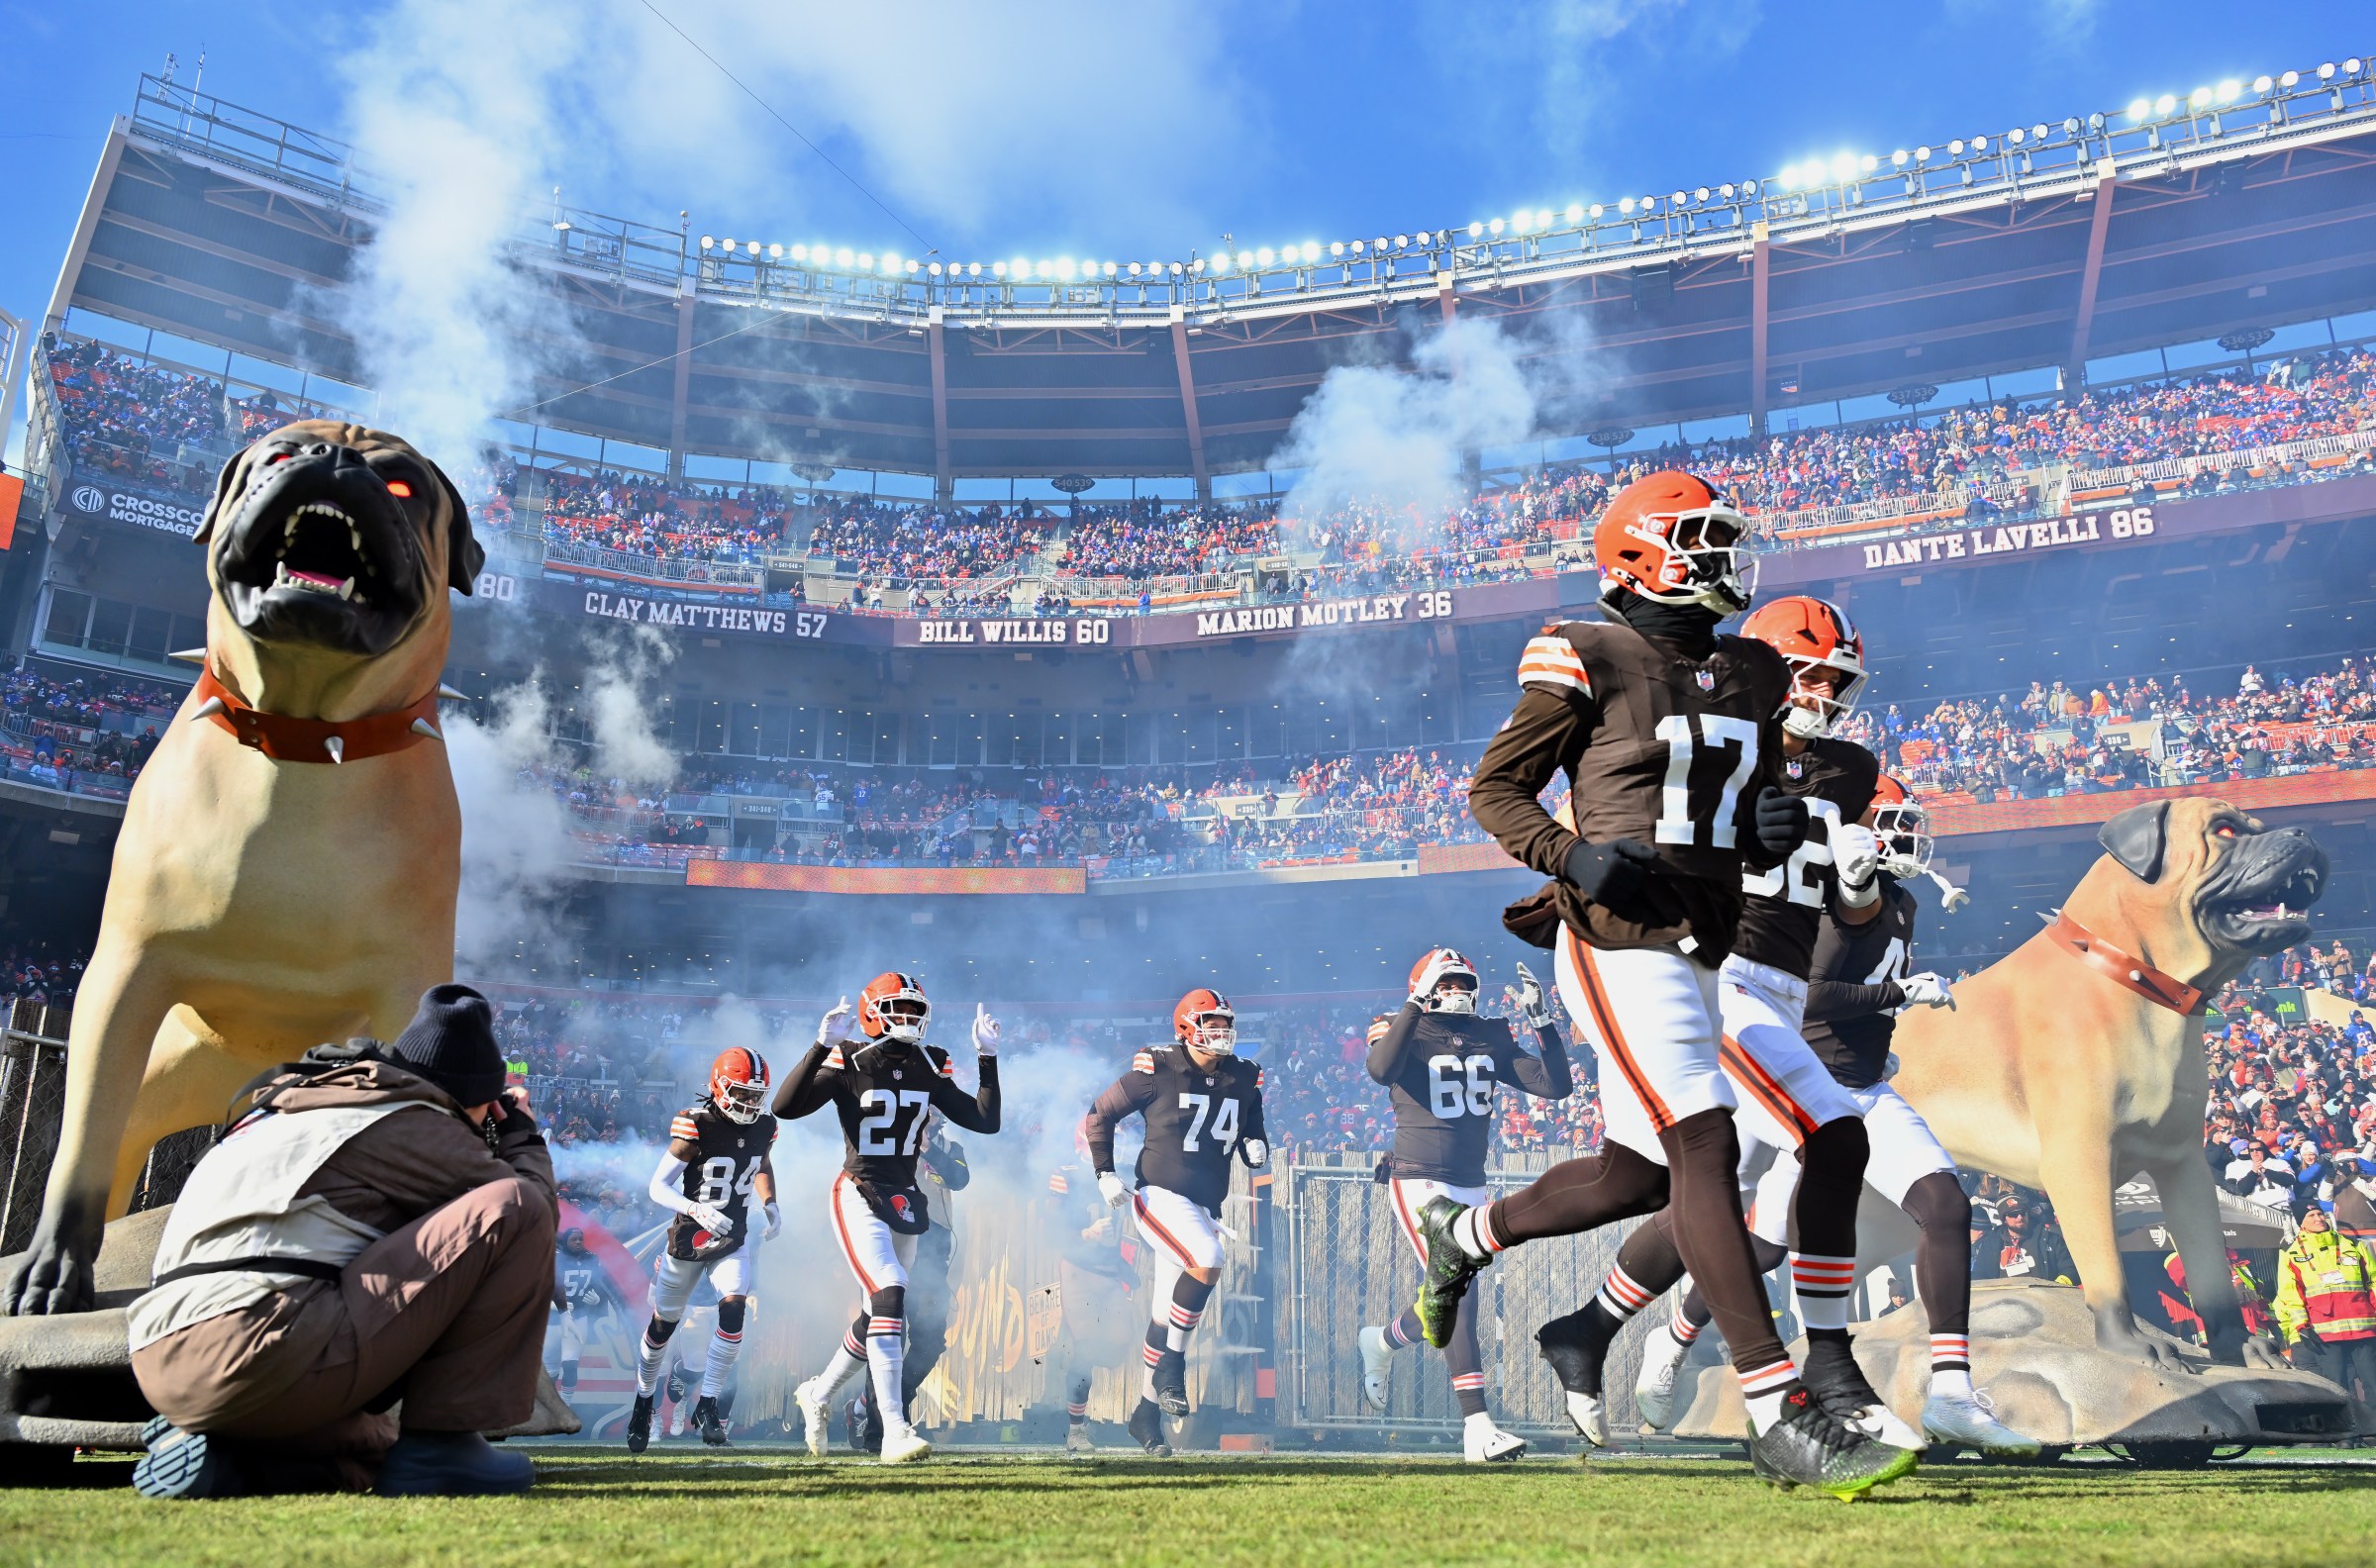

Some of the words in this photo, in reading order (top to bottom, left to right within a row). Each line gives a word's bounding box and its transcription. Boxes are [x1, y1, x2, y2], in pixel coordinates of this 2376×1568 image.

[1054, 478, 1073, 487] 540
[1074, 478, 1092, 487] 539
[109, 508, 195, 537] MORTGAGE
[111, 493, 205, 527] CROSSCO
[1863, 533, 1966, 570] DANTE
[1970, 515, 2101, 555] LAVELLI
[2110, 507, 2155, 539] 86
[478, 572, 515, 602] 80
[584, 591, 645, 622] CLAY
[646, 602, 786, 635] MATTHEWS
[796, 612, 828, 639] 57
[1196, 606, 1295, 637] MARION
[1300, 596, 1409, 627] MOTLEY
[1418, 591, 1452, 619] 36
[919, 621, 975, 642] BILL
[981, 621, 1066, 642] WILLIS
[1076, 619, 1109, 644] 60
[1655, 713, 1759, 849] 17
[1105, 1027, 1114, 1036] 12
[1429, 1054, 1495, 1120] 66
[858, 1089, 931, 1156] 27
[1178, 1092, 1239, 1156] 74
[699, 1155, 763, 1210] 84
[2224, 1228, 2237, 1237] tals
[563, 1269, 592, 1297] 57
[1029, 1287, 1061, 1317] BEWARE
[1040, 1313, 1049, 1327] OF
